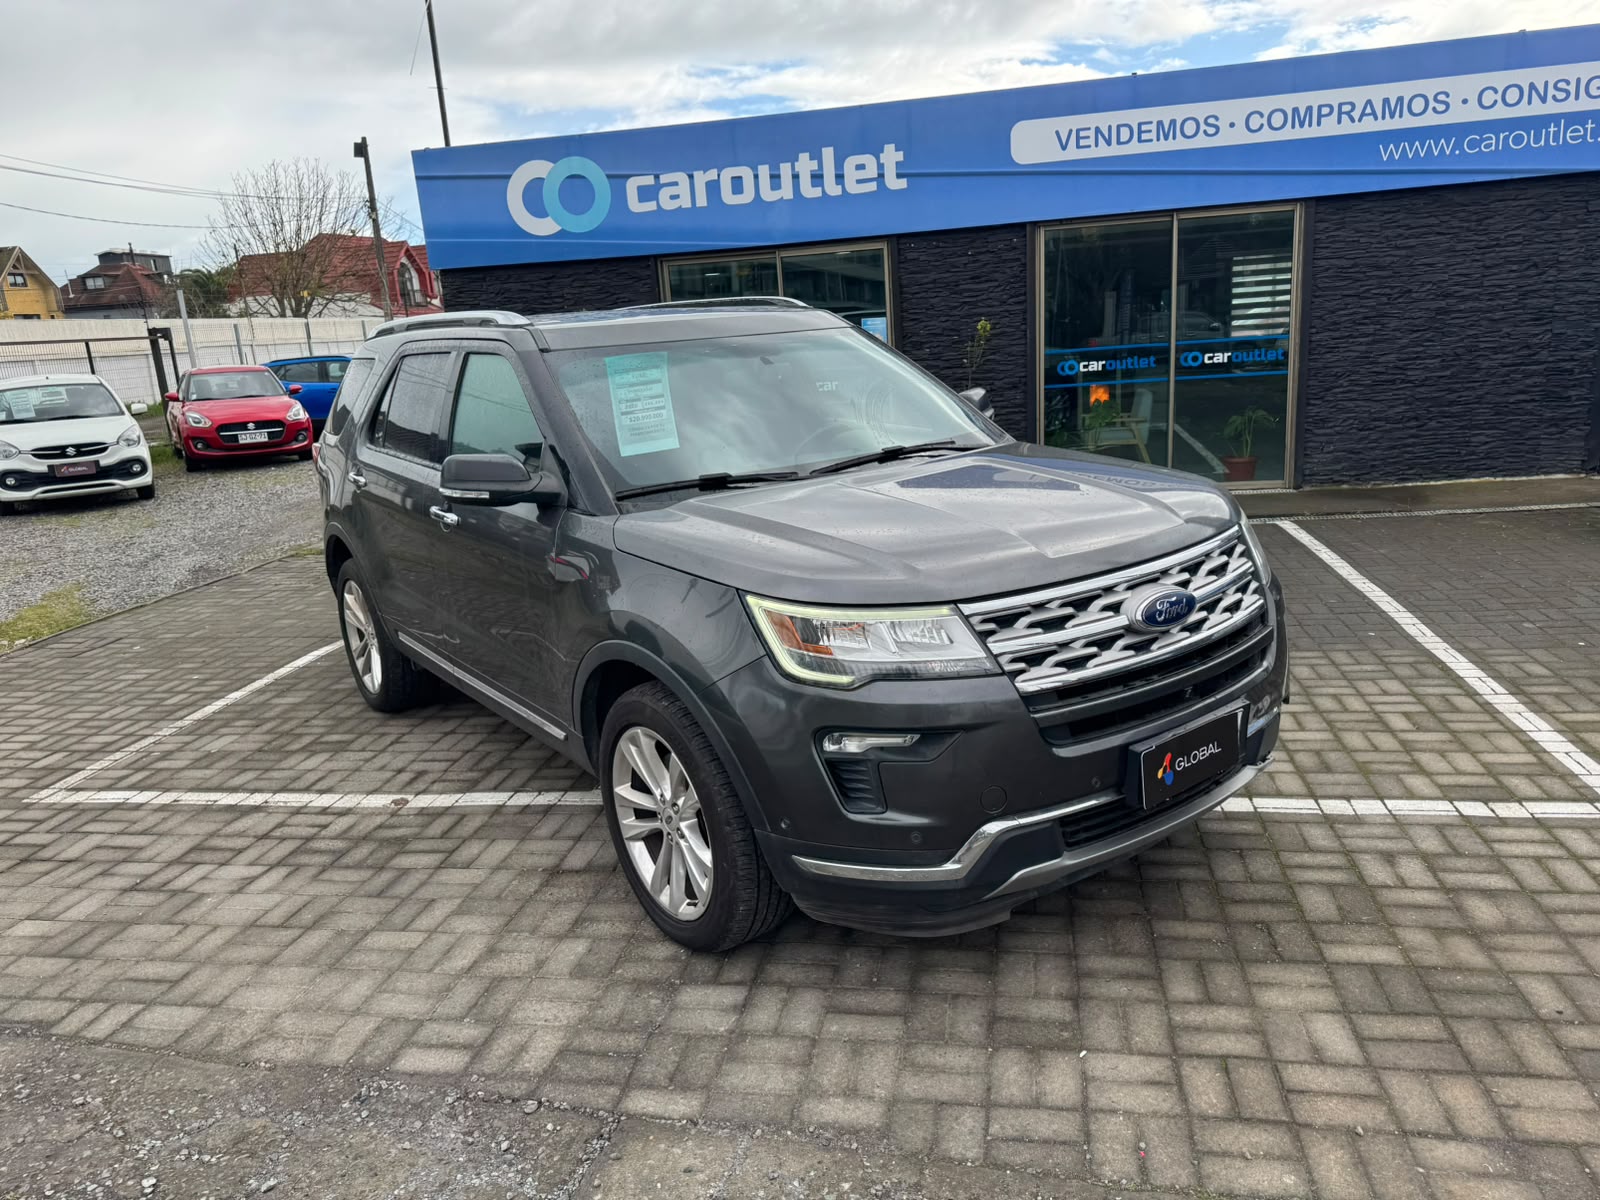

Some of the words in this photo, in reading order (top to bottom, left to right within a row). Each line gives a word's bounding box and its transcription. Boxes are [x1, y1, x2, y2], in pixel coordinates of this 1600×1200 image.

[1055, 115, 1221, 152] VENDEMOS
[1245, 91, 1451, 134] COMPRAMOS
[625, 143, 908, 213] caroutlet
[1155, 596, 1189, 622] Ford
[1175, 741, 1222, 771] GLOBAL
